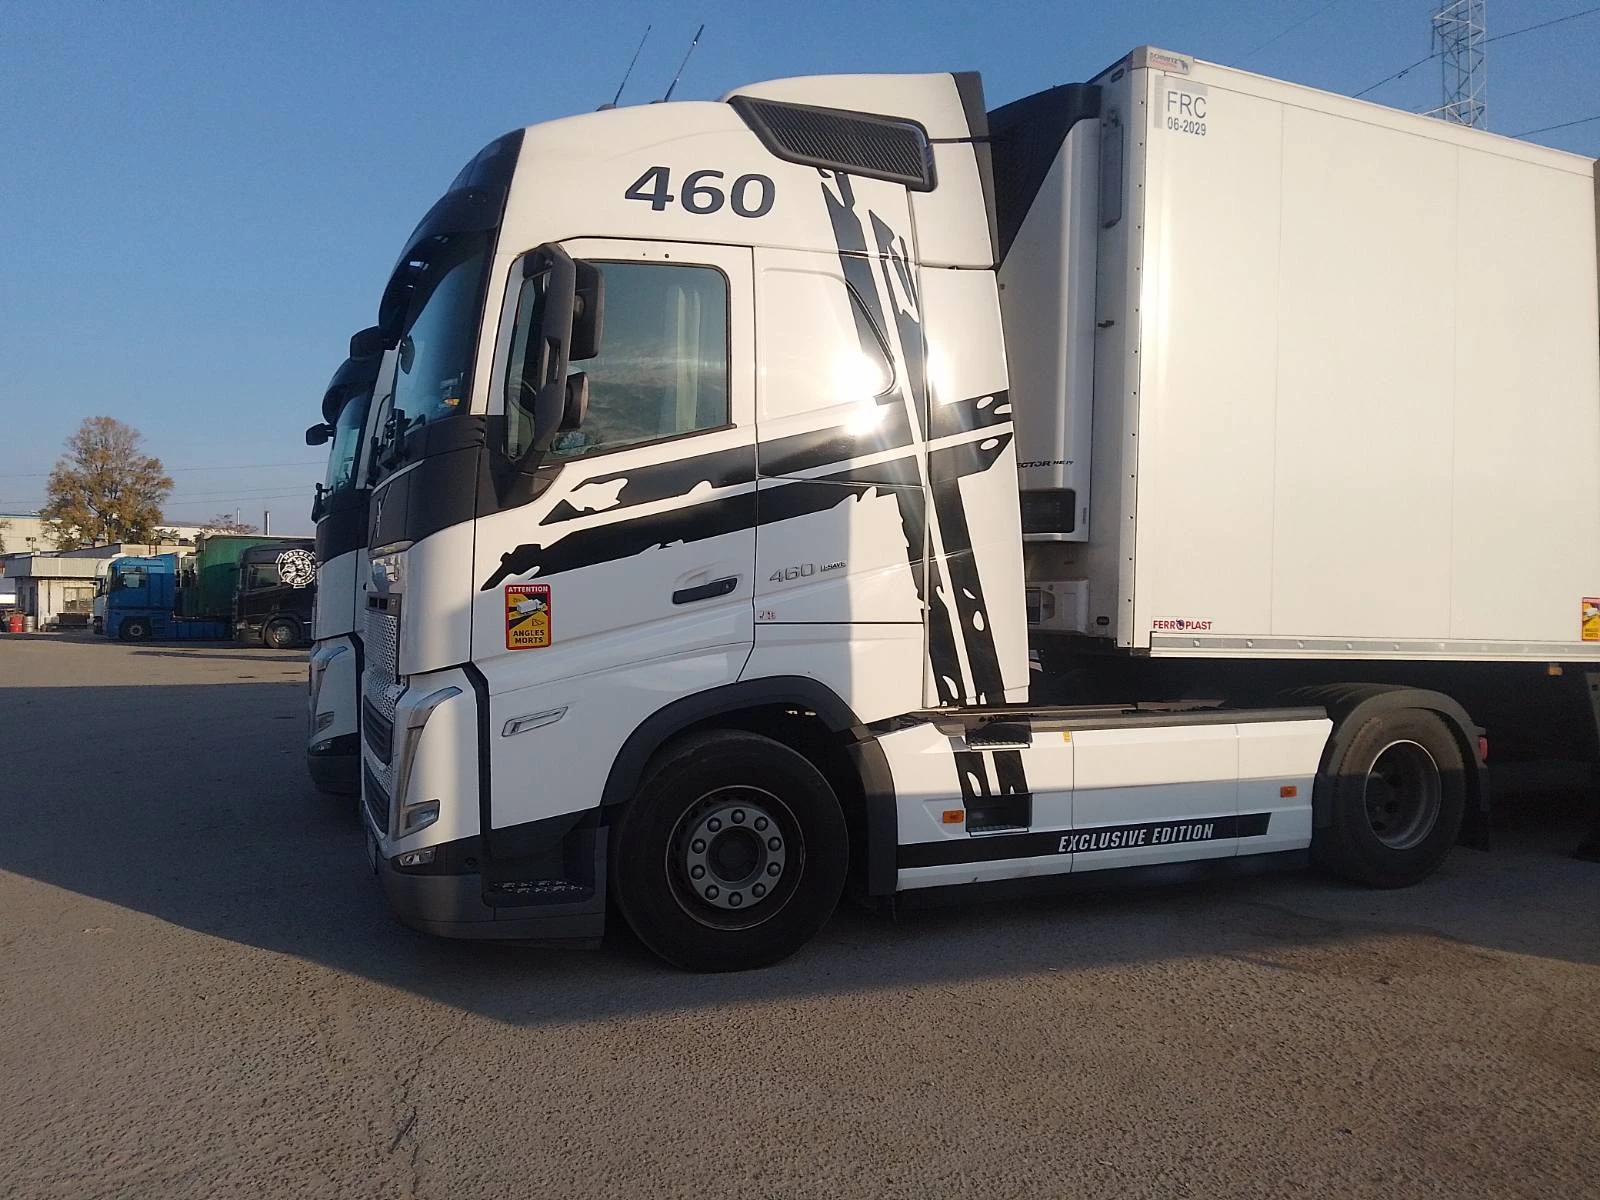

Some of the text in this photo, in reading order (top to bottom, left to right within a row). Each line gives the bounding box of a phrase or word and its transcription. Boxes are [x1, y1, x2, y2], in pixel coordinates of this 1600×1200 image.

[1167, 90, 1207, 119] FRC
[1167, 116, 1207, 136] 06-2029
[625, 166, 775, 218] 460
[769, 563, 815, 583] 460
[513, 629, 545, 637] ANGLES
[515, 636, 544, 644] MORTS
[1058, 823, 1214, 852] EXCLUSIVE EDITION
